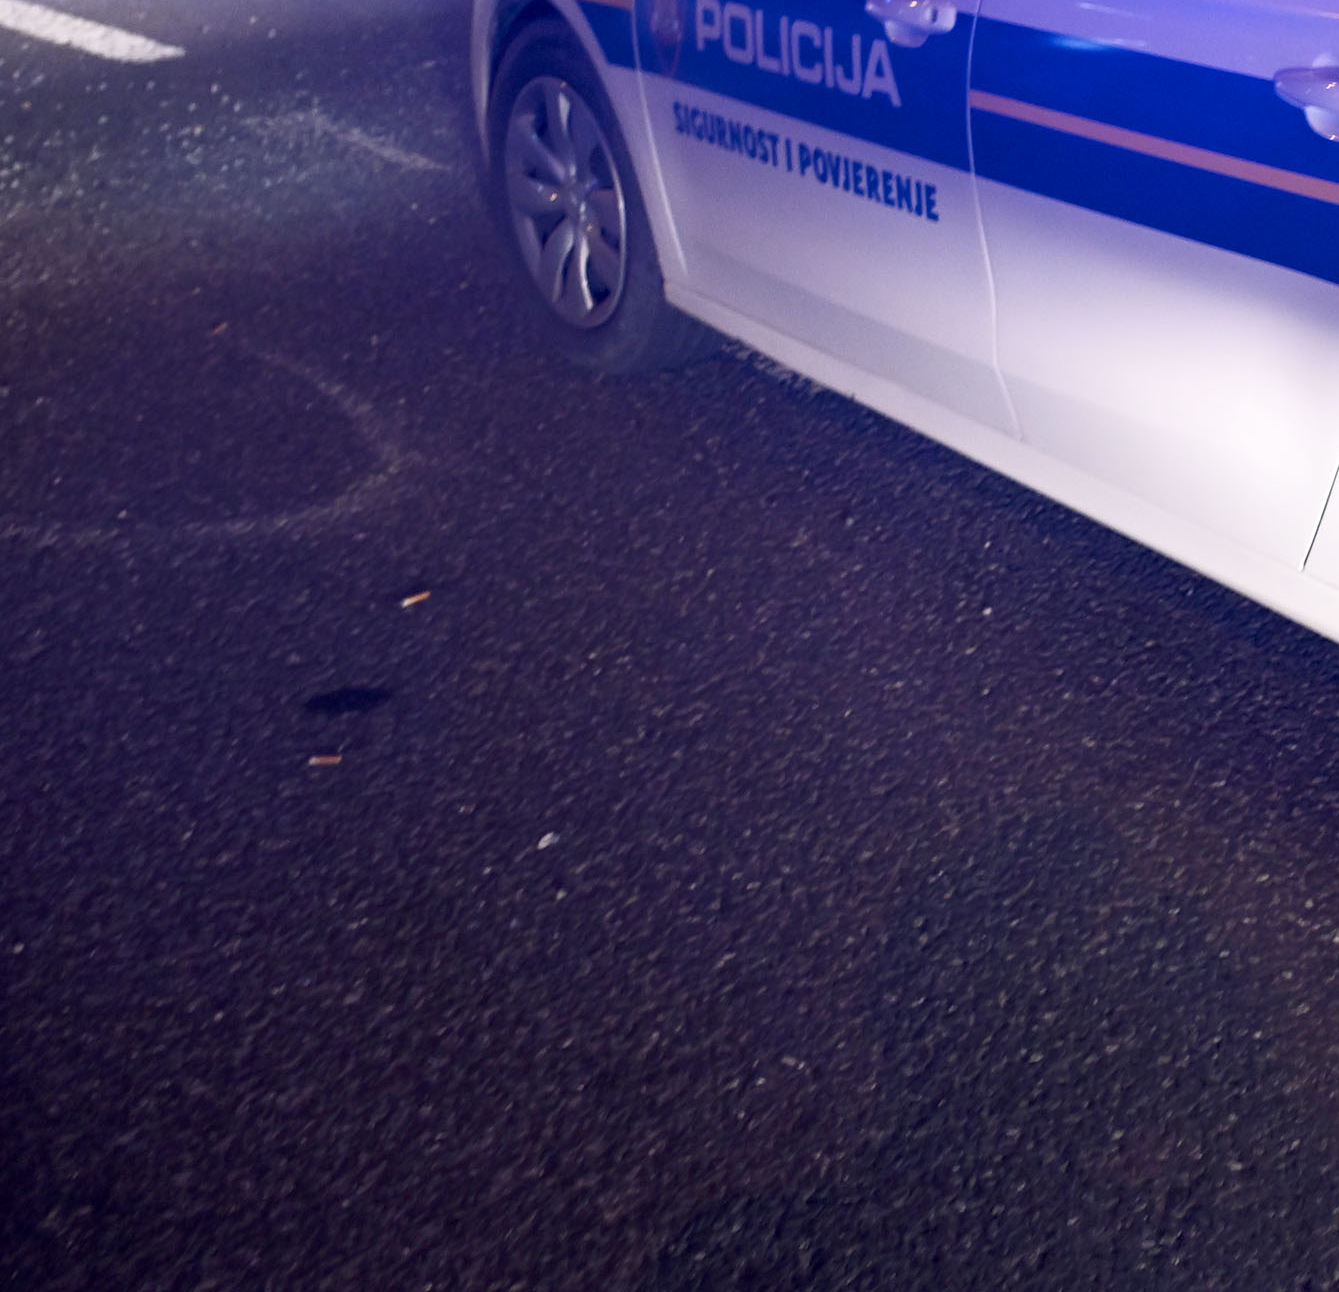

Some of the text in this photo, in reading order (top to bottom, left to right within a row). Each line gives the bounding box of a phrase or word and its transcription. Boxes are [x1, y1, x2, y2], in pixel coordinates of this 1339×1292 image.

[673, 102, 940, 222] SIGURNOST I POVJERENJE
